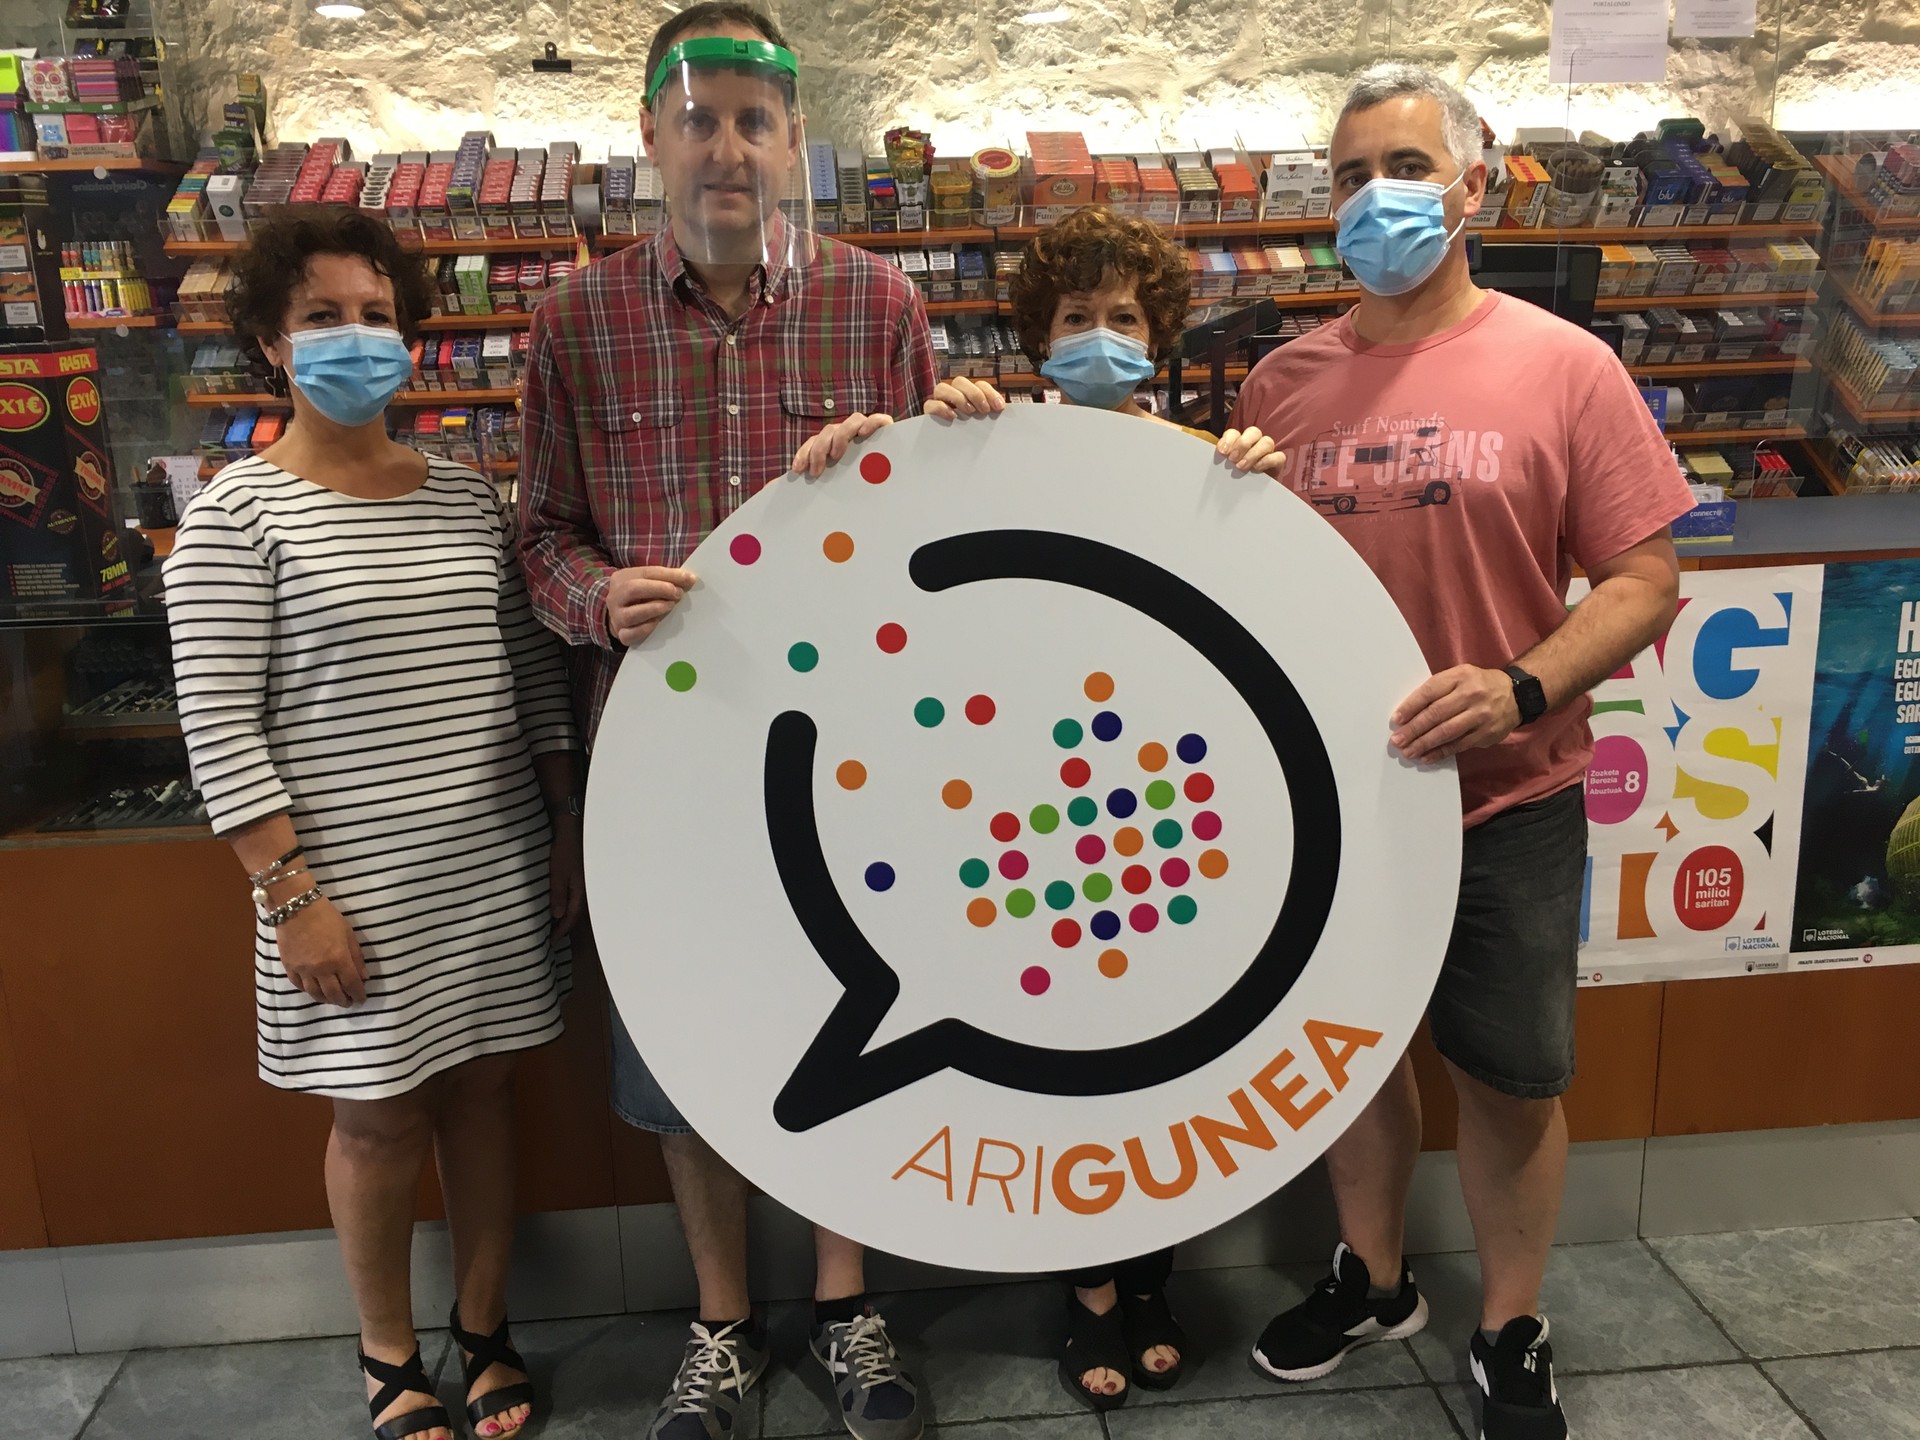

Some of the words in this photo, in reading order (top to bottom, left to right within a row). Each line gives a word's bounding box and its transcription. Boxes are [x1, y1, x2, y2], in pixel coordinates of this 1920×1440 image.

[59, 353, 92, 372] RASTA
[70, 389, 97, 411] 2X1€
[1331, 417, 1372, 438] Surf
[1376, 411, 1446, 434] Nomads
[1373, 430, 1504, 487] JEANS
[100, 560, 128, 583] 78MM
[1590, 769, 1620, 777] Zozketa
[1590, 777, 1618, 785] Berezia
[1624, 770, 1640, 793] 8
[1589, 787, 1623, 795] Abuztuak
[1695, 867, 1732, 887] 105
[1695, 886, 1731, 899] milioi
[1695, 898, 1730, 909] saritan
[1742, 942, 1780, 950] NACIONAL
[1817, 933, 1850, 942] NACIONAL
[891, 1018, 1384, 1215] ARIGUNEA
